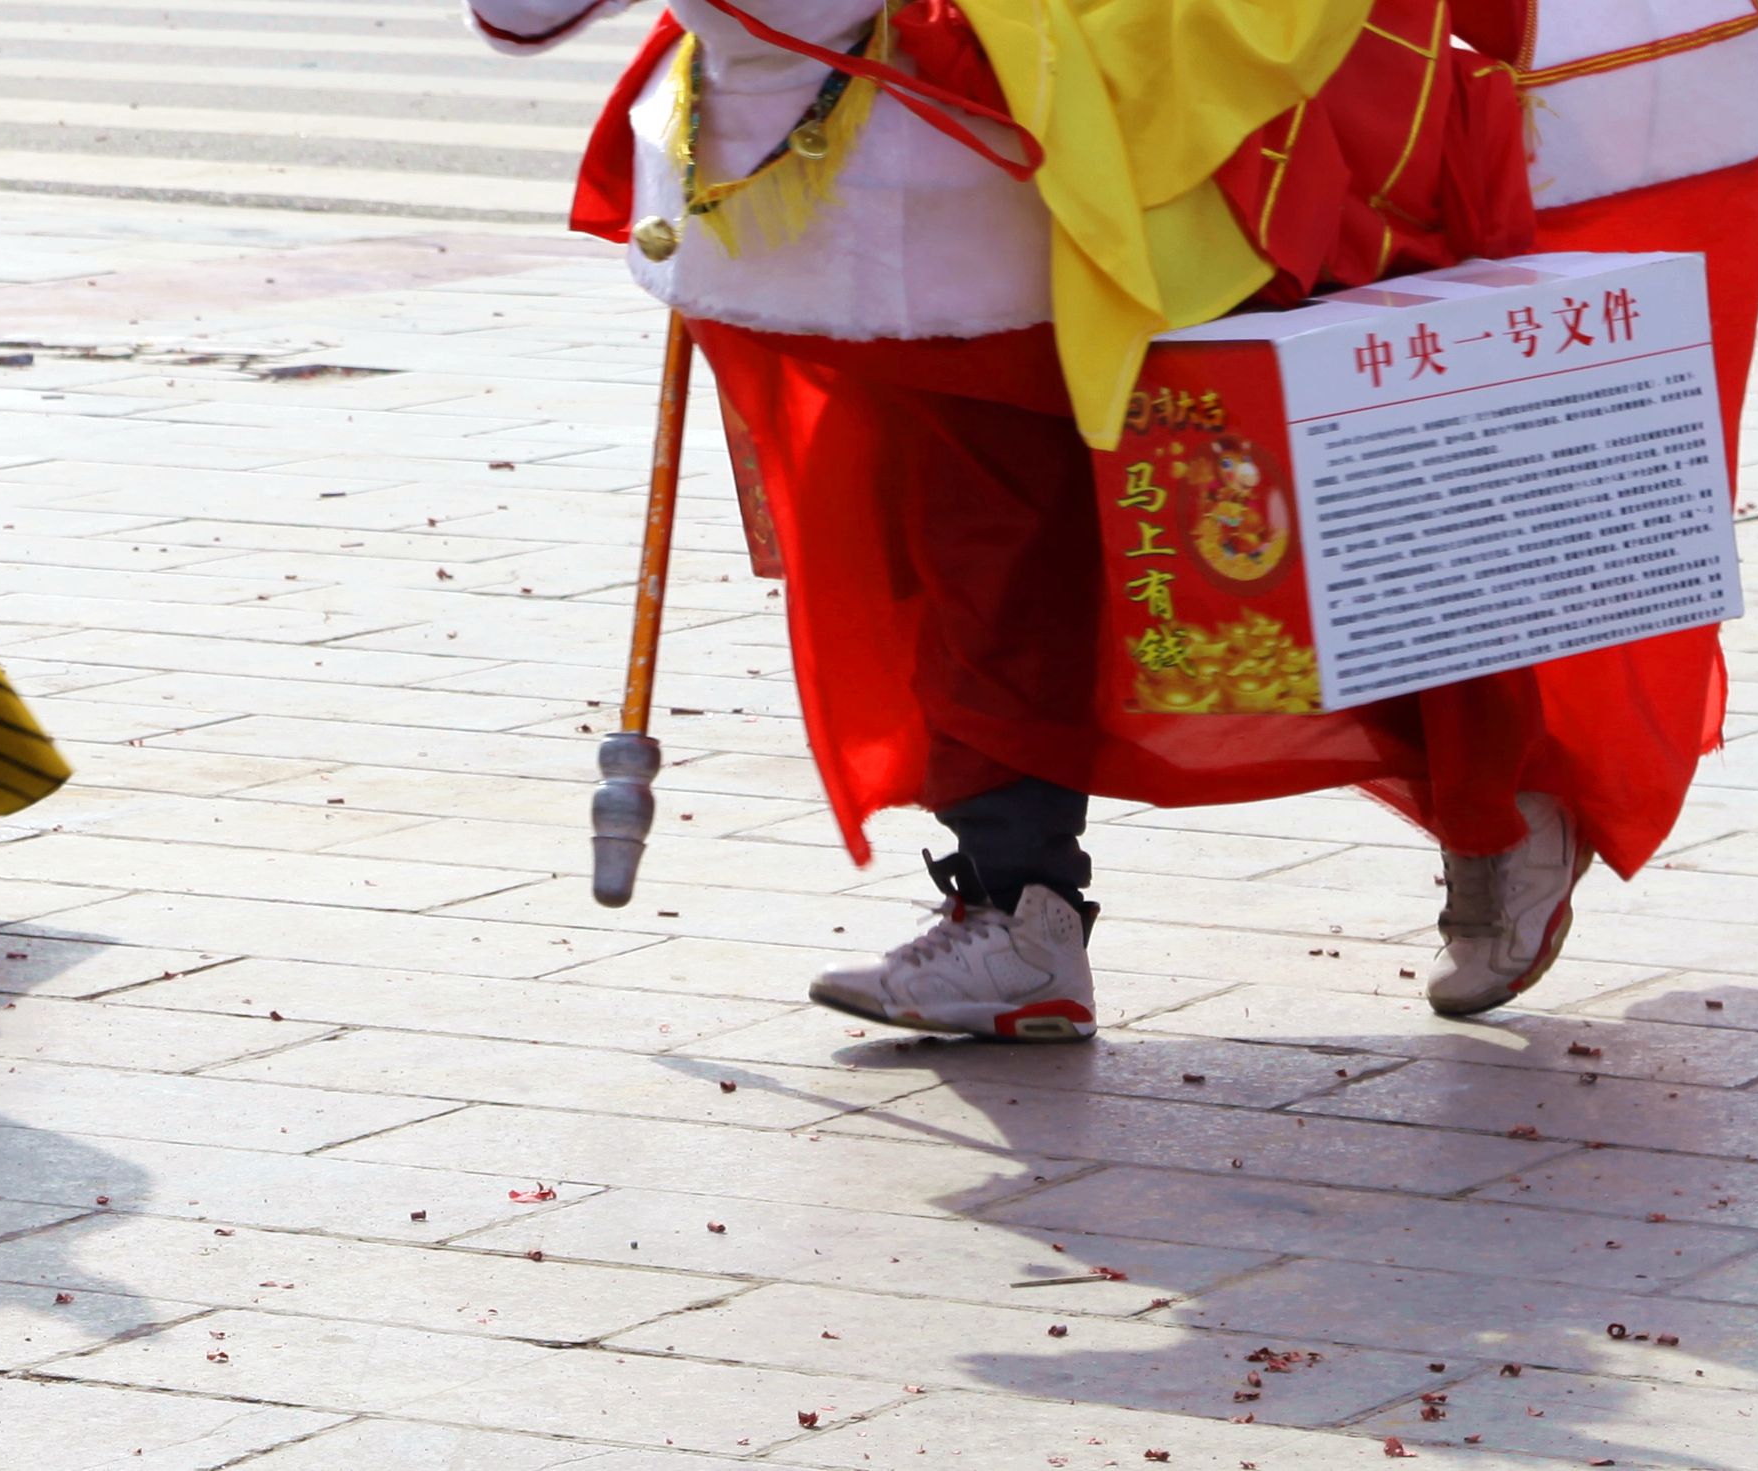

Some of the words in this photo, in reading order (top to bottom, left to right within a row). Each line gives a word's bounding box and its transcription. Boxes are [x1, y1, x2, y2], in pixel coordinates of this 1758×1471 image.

[1353, 287, 1641, 388] 中央一号文件
